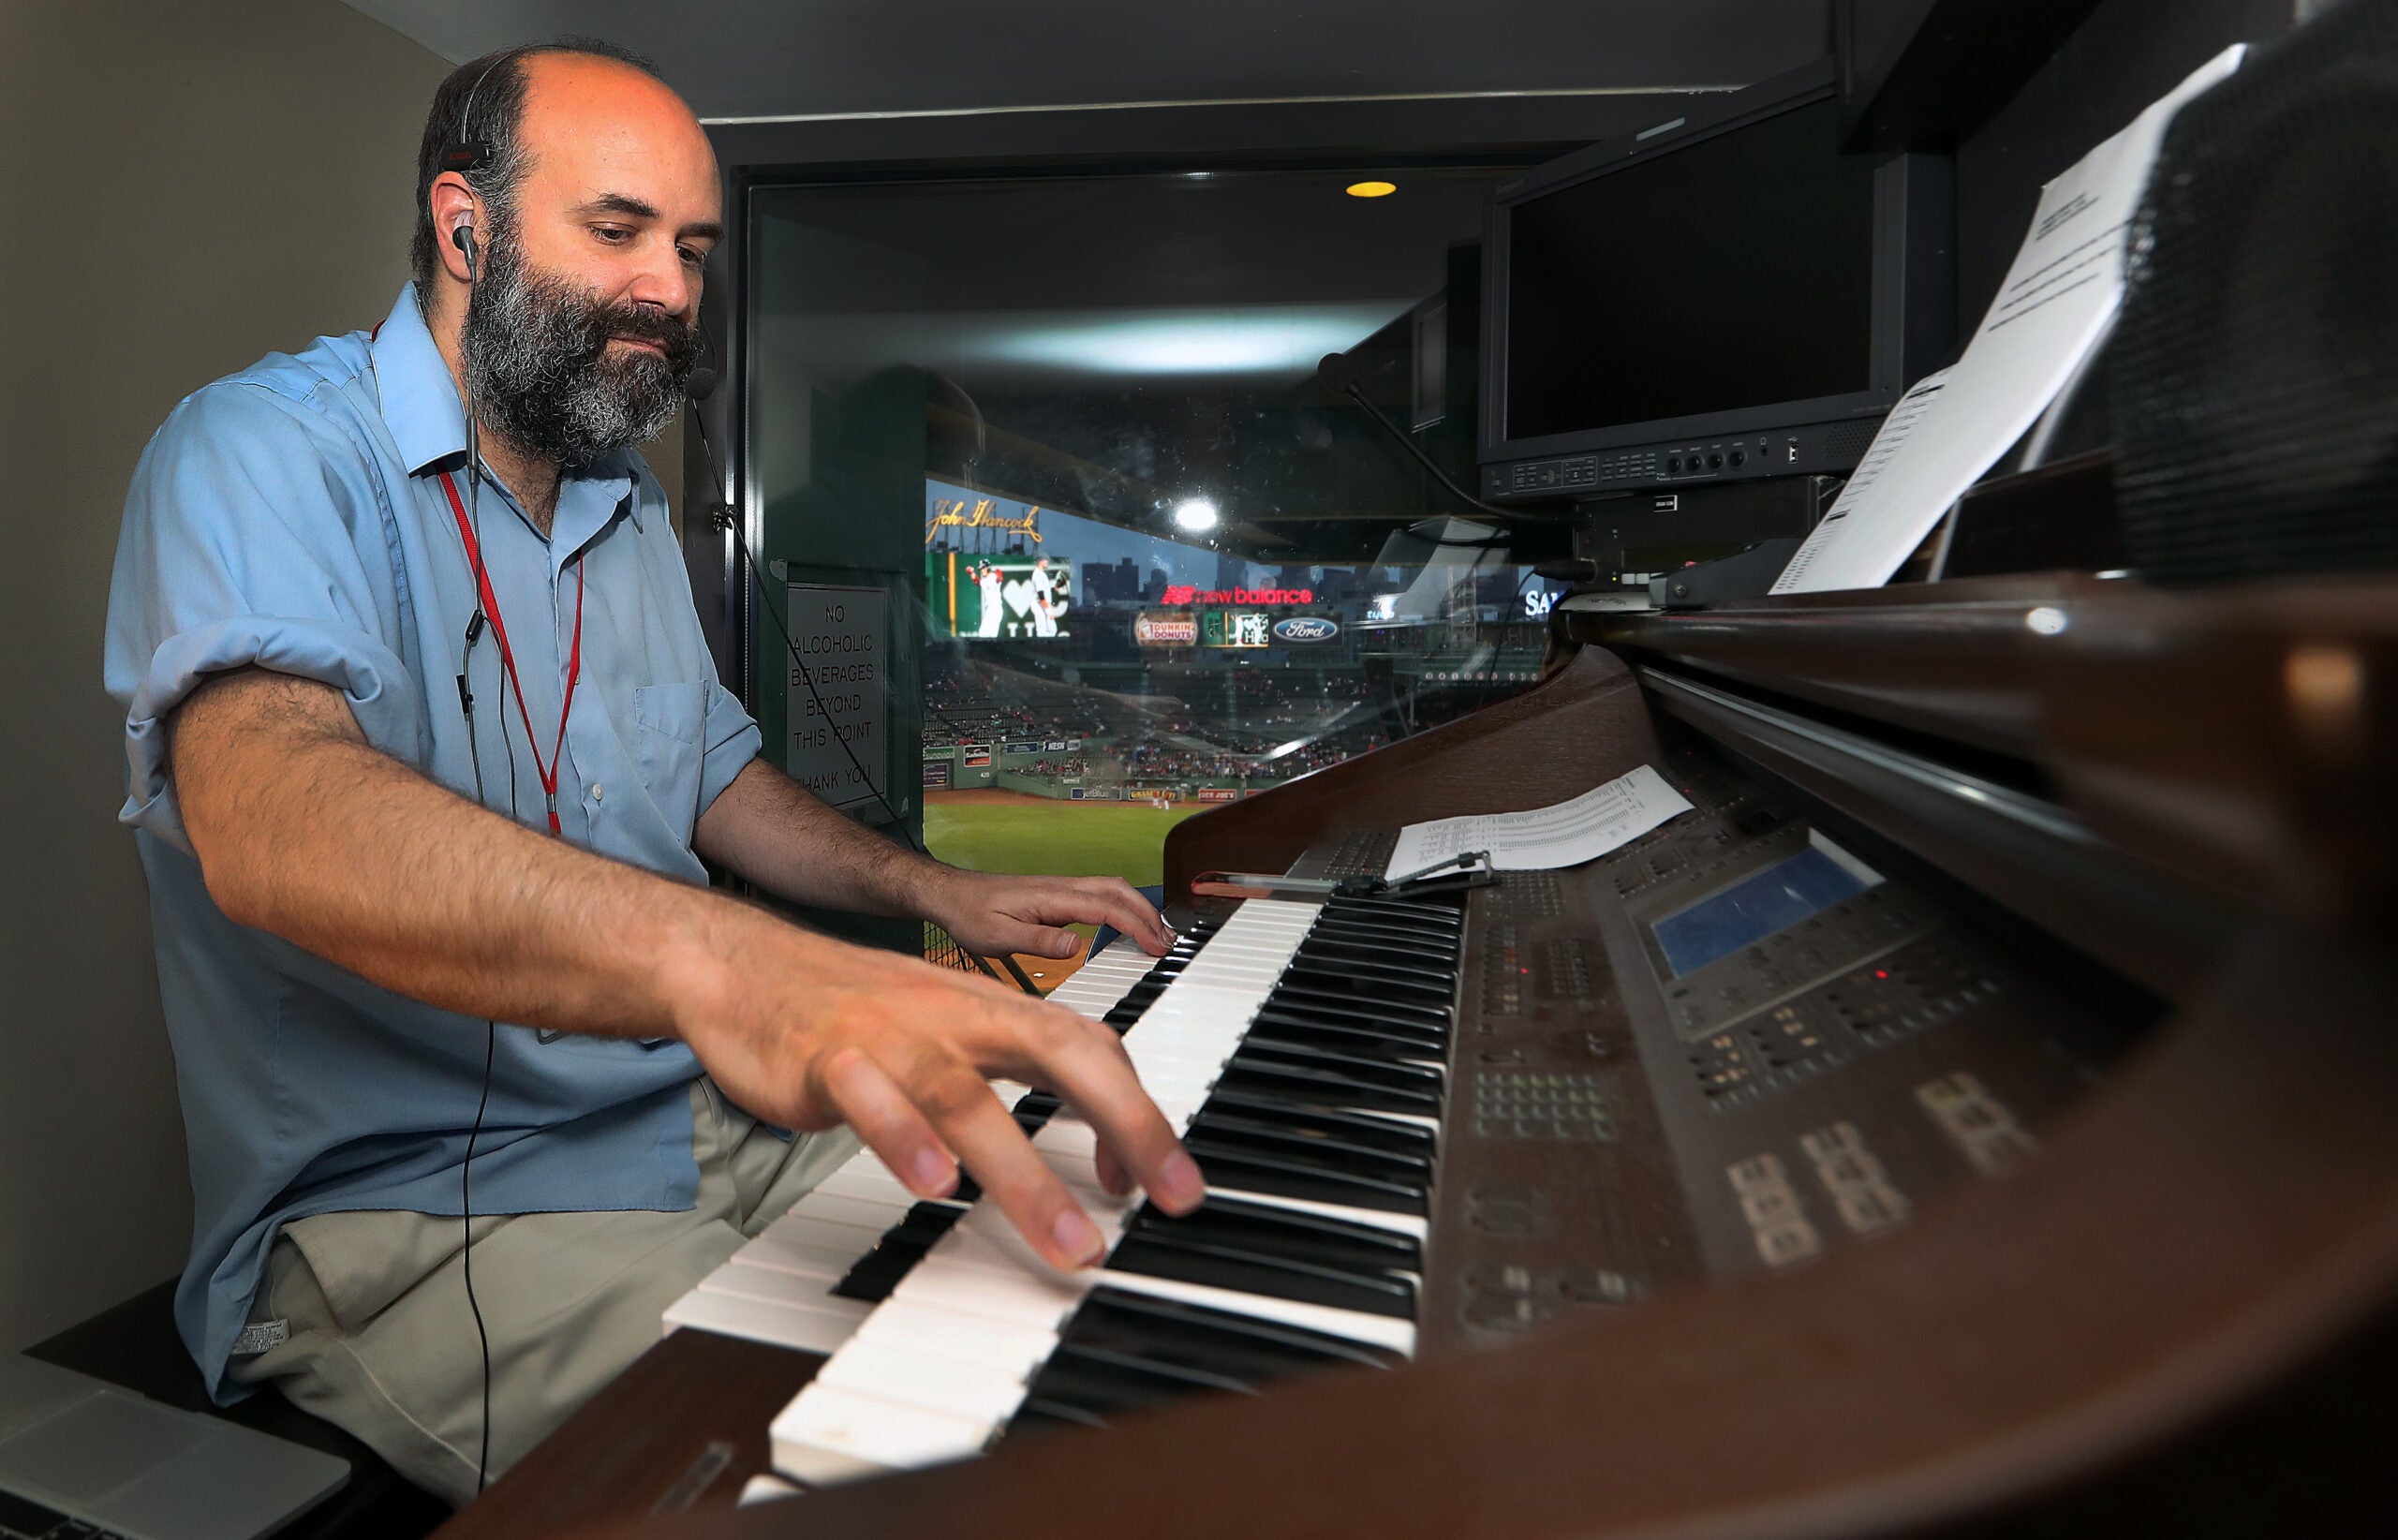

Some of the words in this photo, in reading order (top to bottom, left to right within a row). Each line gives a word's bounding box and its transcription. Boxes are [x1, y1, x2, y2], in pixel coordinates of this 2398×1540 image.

[925, 499, 968, 543] John
[965, 499, 1043, 542] Hancock
[1196, 589, 1233, 604] new
[1235, 585, 1313, 605] balance
[825, 605, 844, 623] NO
[1154, 623, 1193, 631] DUNKIN'
[1154, 630, 1192, 639] DONUTS
[1284, 620, 1325, 638] Ford
[793, 634, 872, 655] ALCOHOLIC
[792, 663, 873, 687] BEVERAGES
[807, 694, 861, 717] BEYOND
[793, 729, 826, 749] THIS
[834, 722, 872, 745] POINT
[797, 771, 839, 792] HANK
[845, 764, 871, 785] YOU
